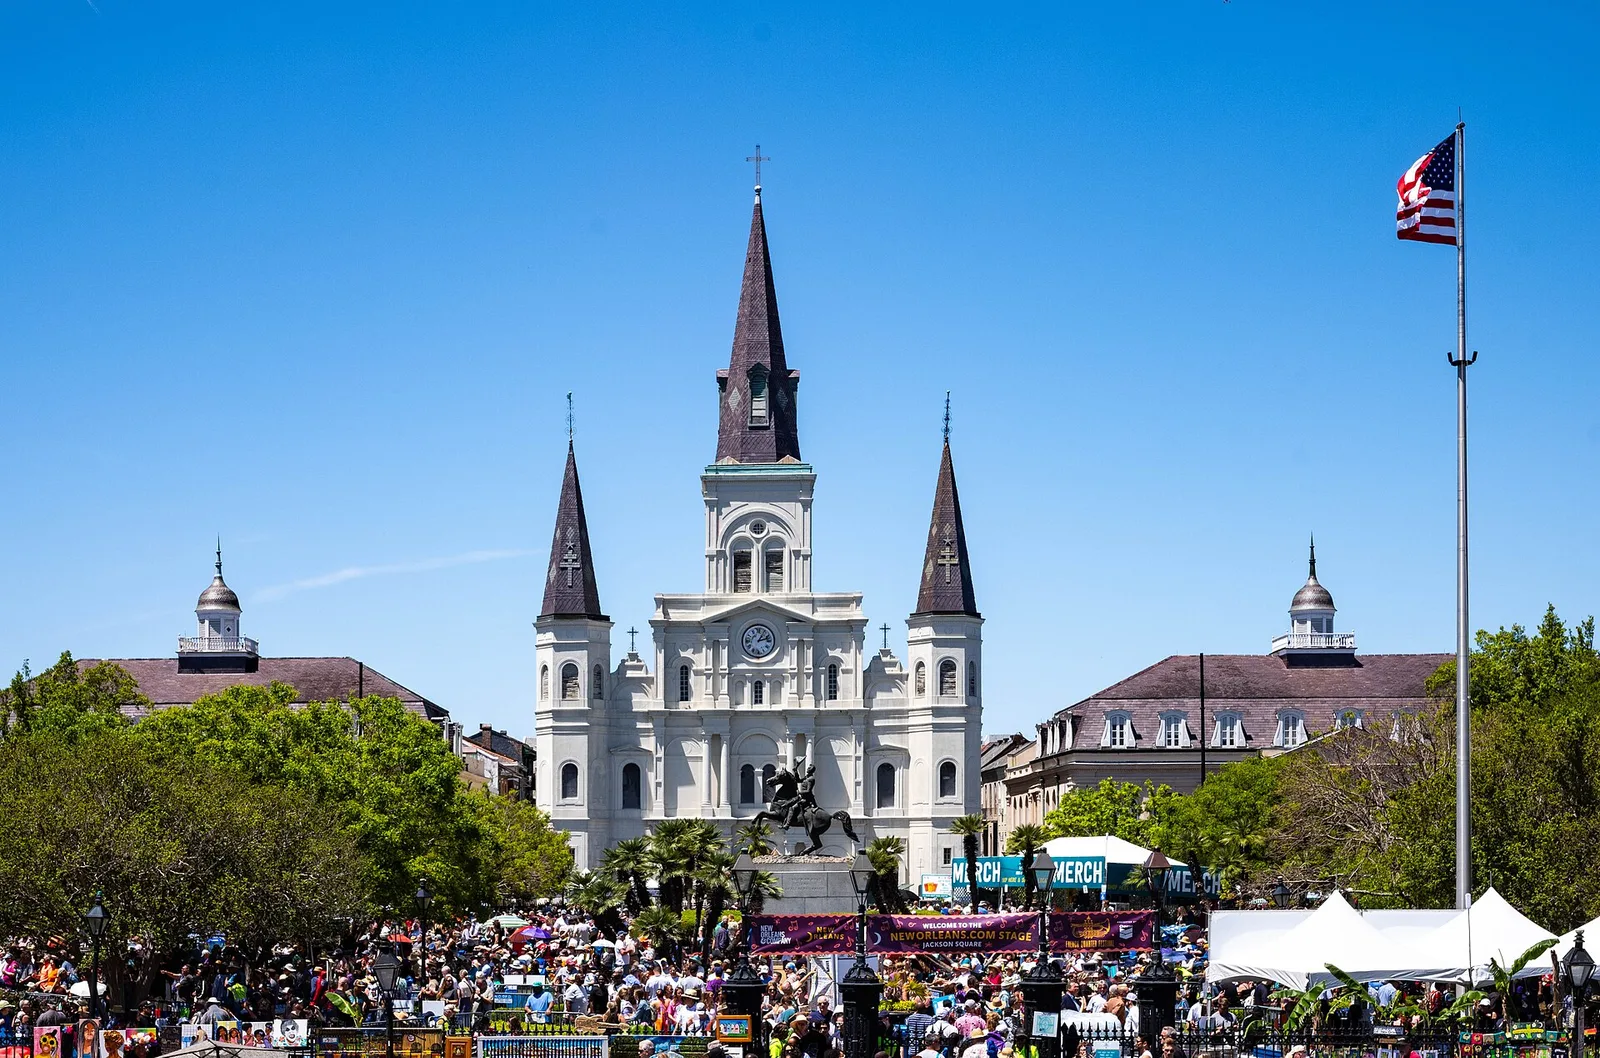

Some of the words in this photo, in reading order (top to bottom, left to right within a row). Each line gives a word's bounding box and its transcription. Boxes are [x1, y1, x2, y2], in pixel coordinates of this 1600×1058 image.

[1053, 860, 1103, 884] MERCH
[1166, 869, 1222, 894] MECH
[760, 924, 774, 932] NEW
[760, 931, 786, 939] ORLEANS
[890, 930, 996, 942] NEWORLEANS.COM
[998, 931, 1032, 942] STAGE
[922, 941, 954, 949] JACKSON
